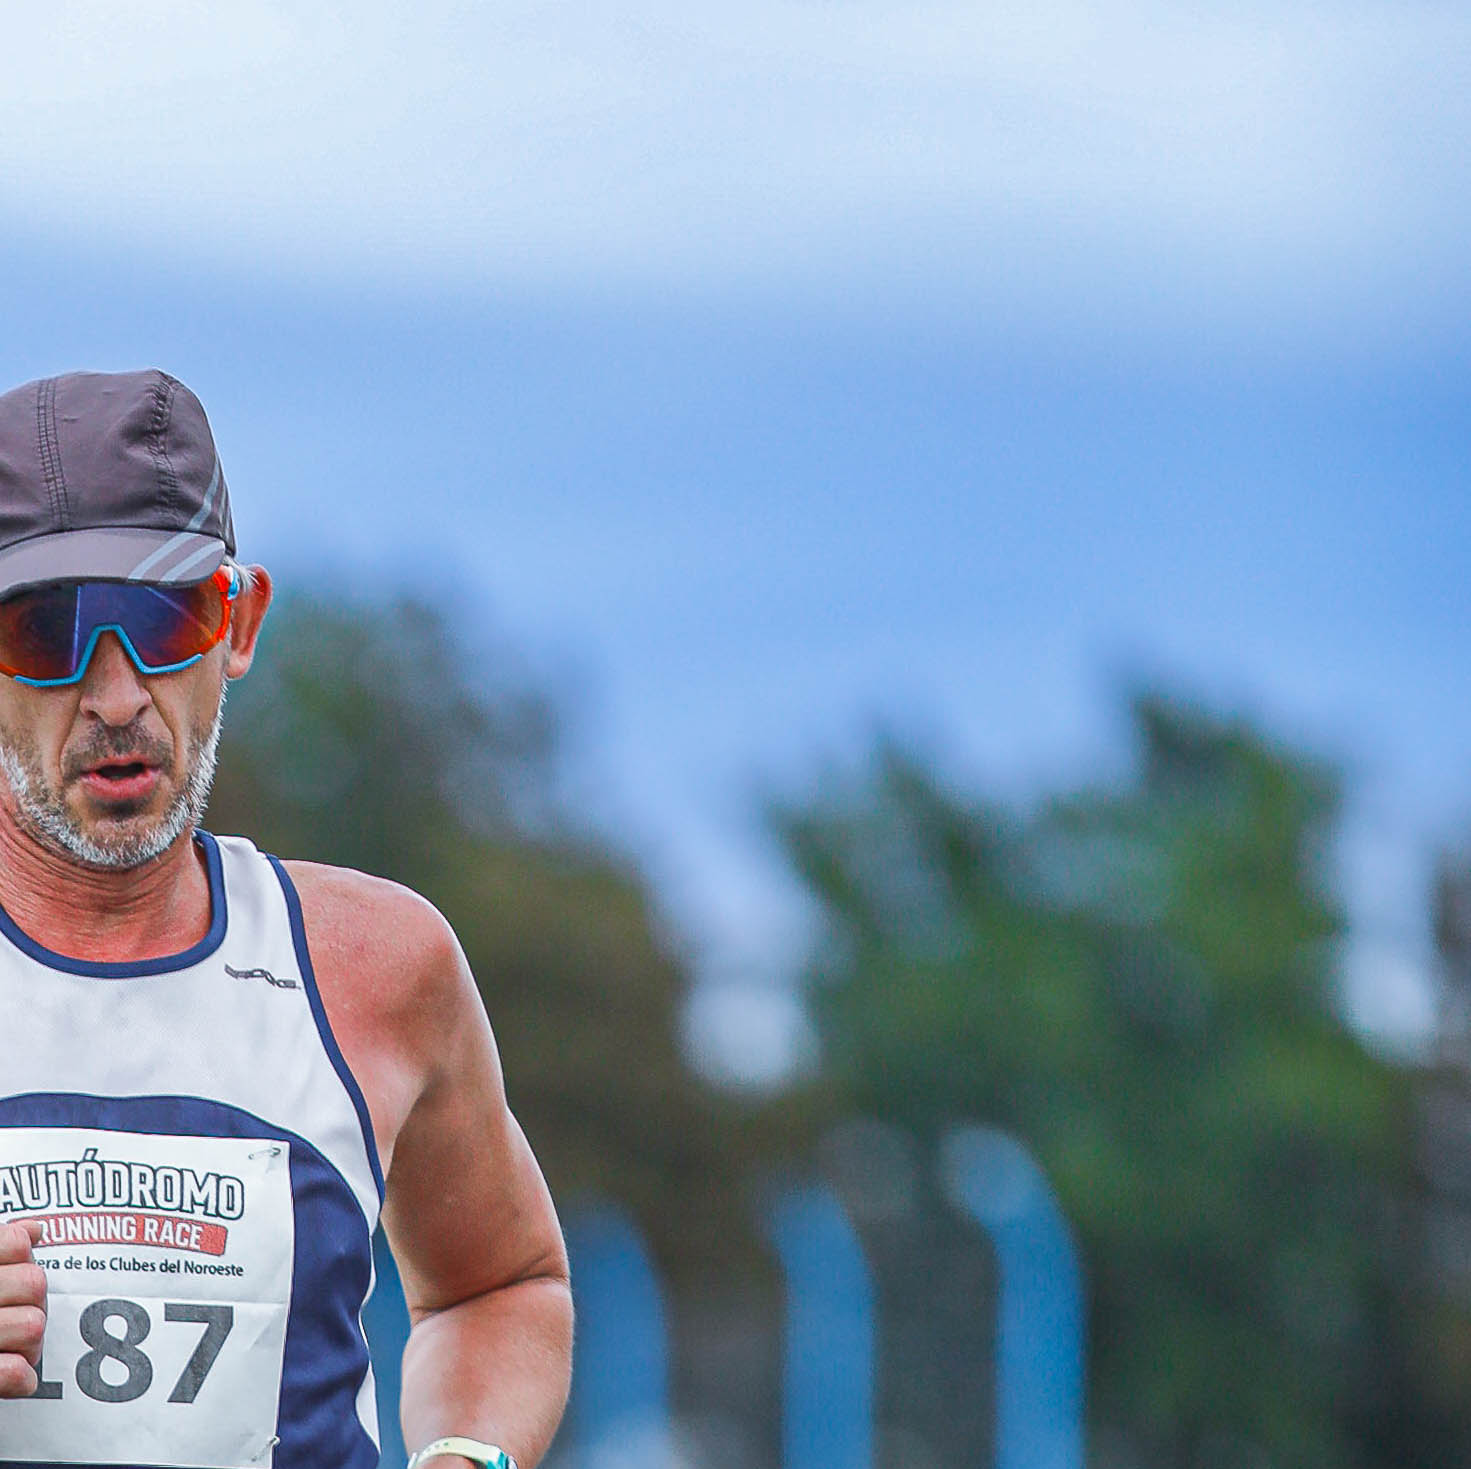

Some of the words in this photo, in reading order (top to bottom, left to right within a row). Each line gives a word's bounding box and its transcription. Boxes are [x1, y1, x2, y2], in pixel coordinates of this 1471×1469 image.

[144, 1218, 203, 1250] RACE
[64, 1256, 82, 1270] de
[86, 1256, 106, 1271] los
[110, 1257, 156, 1272] Clubes
[159, 1259, 180, 1273] del
[184, 1260, 244, 1276] Noroeste
